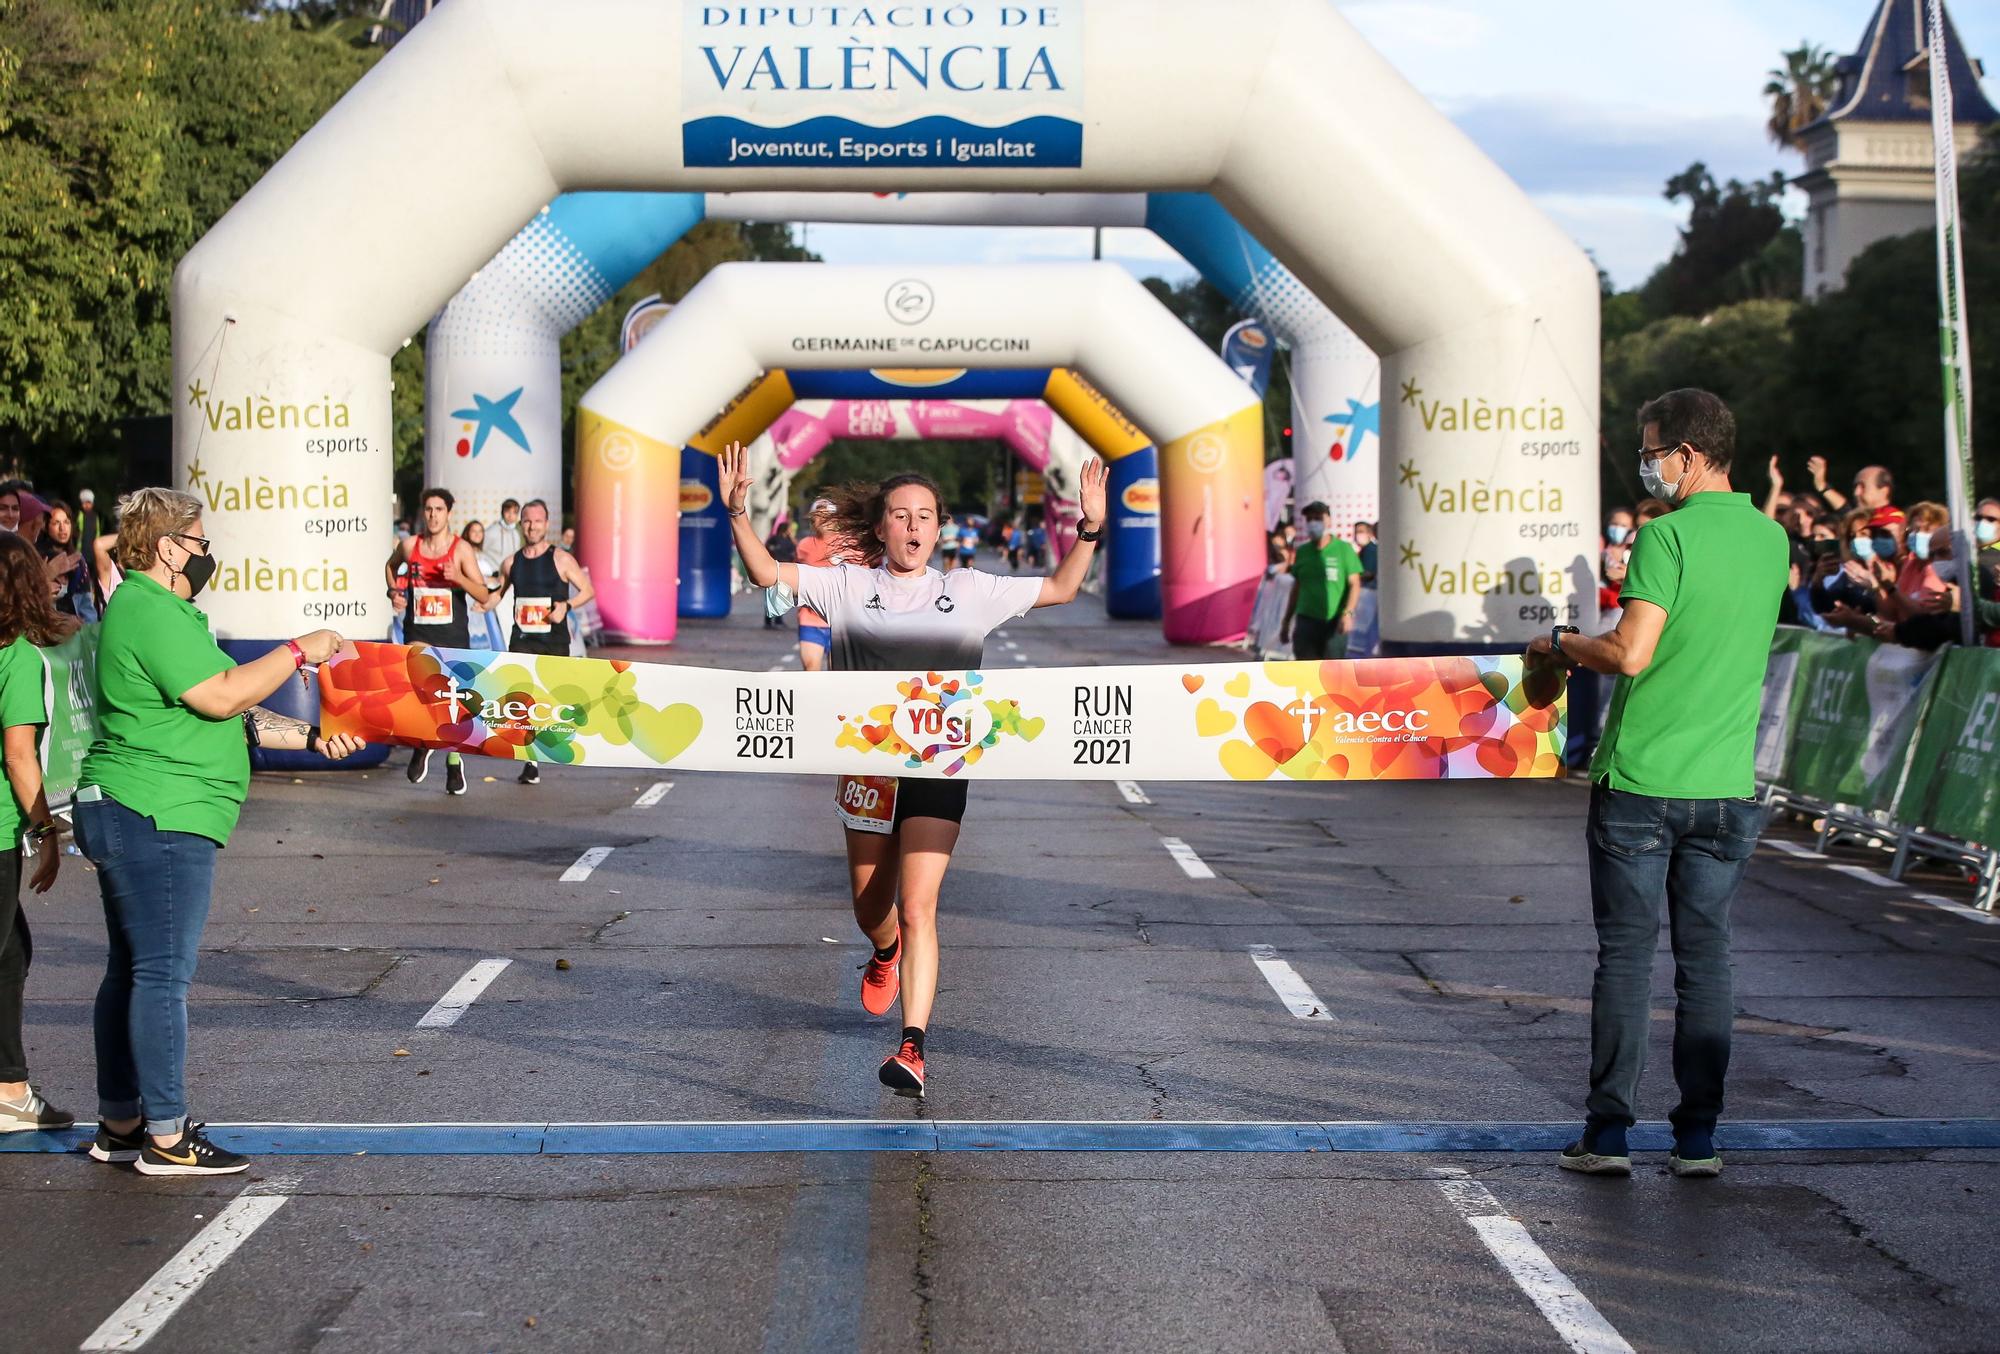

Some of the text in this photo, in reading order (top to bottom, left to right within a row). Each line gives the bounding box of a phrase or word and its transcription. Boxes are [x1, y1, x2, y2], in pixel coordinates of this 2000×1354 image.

[702, 3, 1060, 27] DIPUTACIÓ DE
[698, 36, 1066, 91] VALÈNCIA
[729, 137, 1036, 162] Joventut, Esports i Igualtat
[792, 337, 897, 352] GERMAINE
[918, 337, 1030, 352] CAPUCCINI
[205, 394, 350, 432] València
[1419, 398, 1565, 432] València
[306, 436, 368, 457] esports
[1521, 440, 1581, 460] esports
[203, 475, 349, 513] València
[1417, 479, 1563, 513] València
[304, 515, 368, 538] esports
[1519, 522, 1579, 541] esports
[208, 559, 349, 593] València
[1417, 561, 1563, 596] València
[303, 599, 367, 621] esports
[1519, 603, 1580, 624] esports
[480, 699, 576, 723] aecc
[736, 687, 794, 715] RUN
[1074, 685, 1132, 716] RUN
[908, 708, 943, 734] YO
[1333, 709, 1429, 734] aecc
[736, 734, 794, 759] 2021
[1073, 739, 1131, 764] 2021
[845, 780, 879, 810] 850
